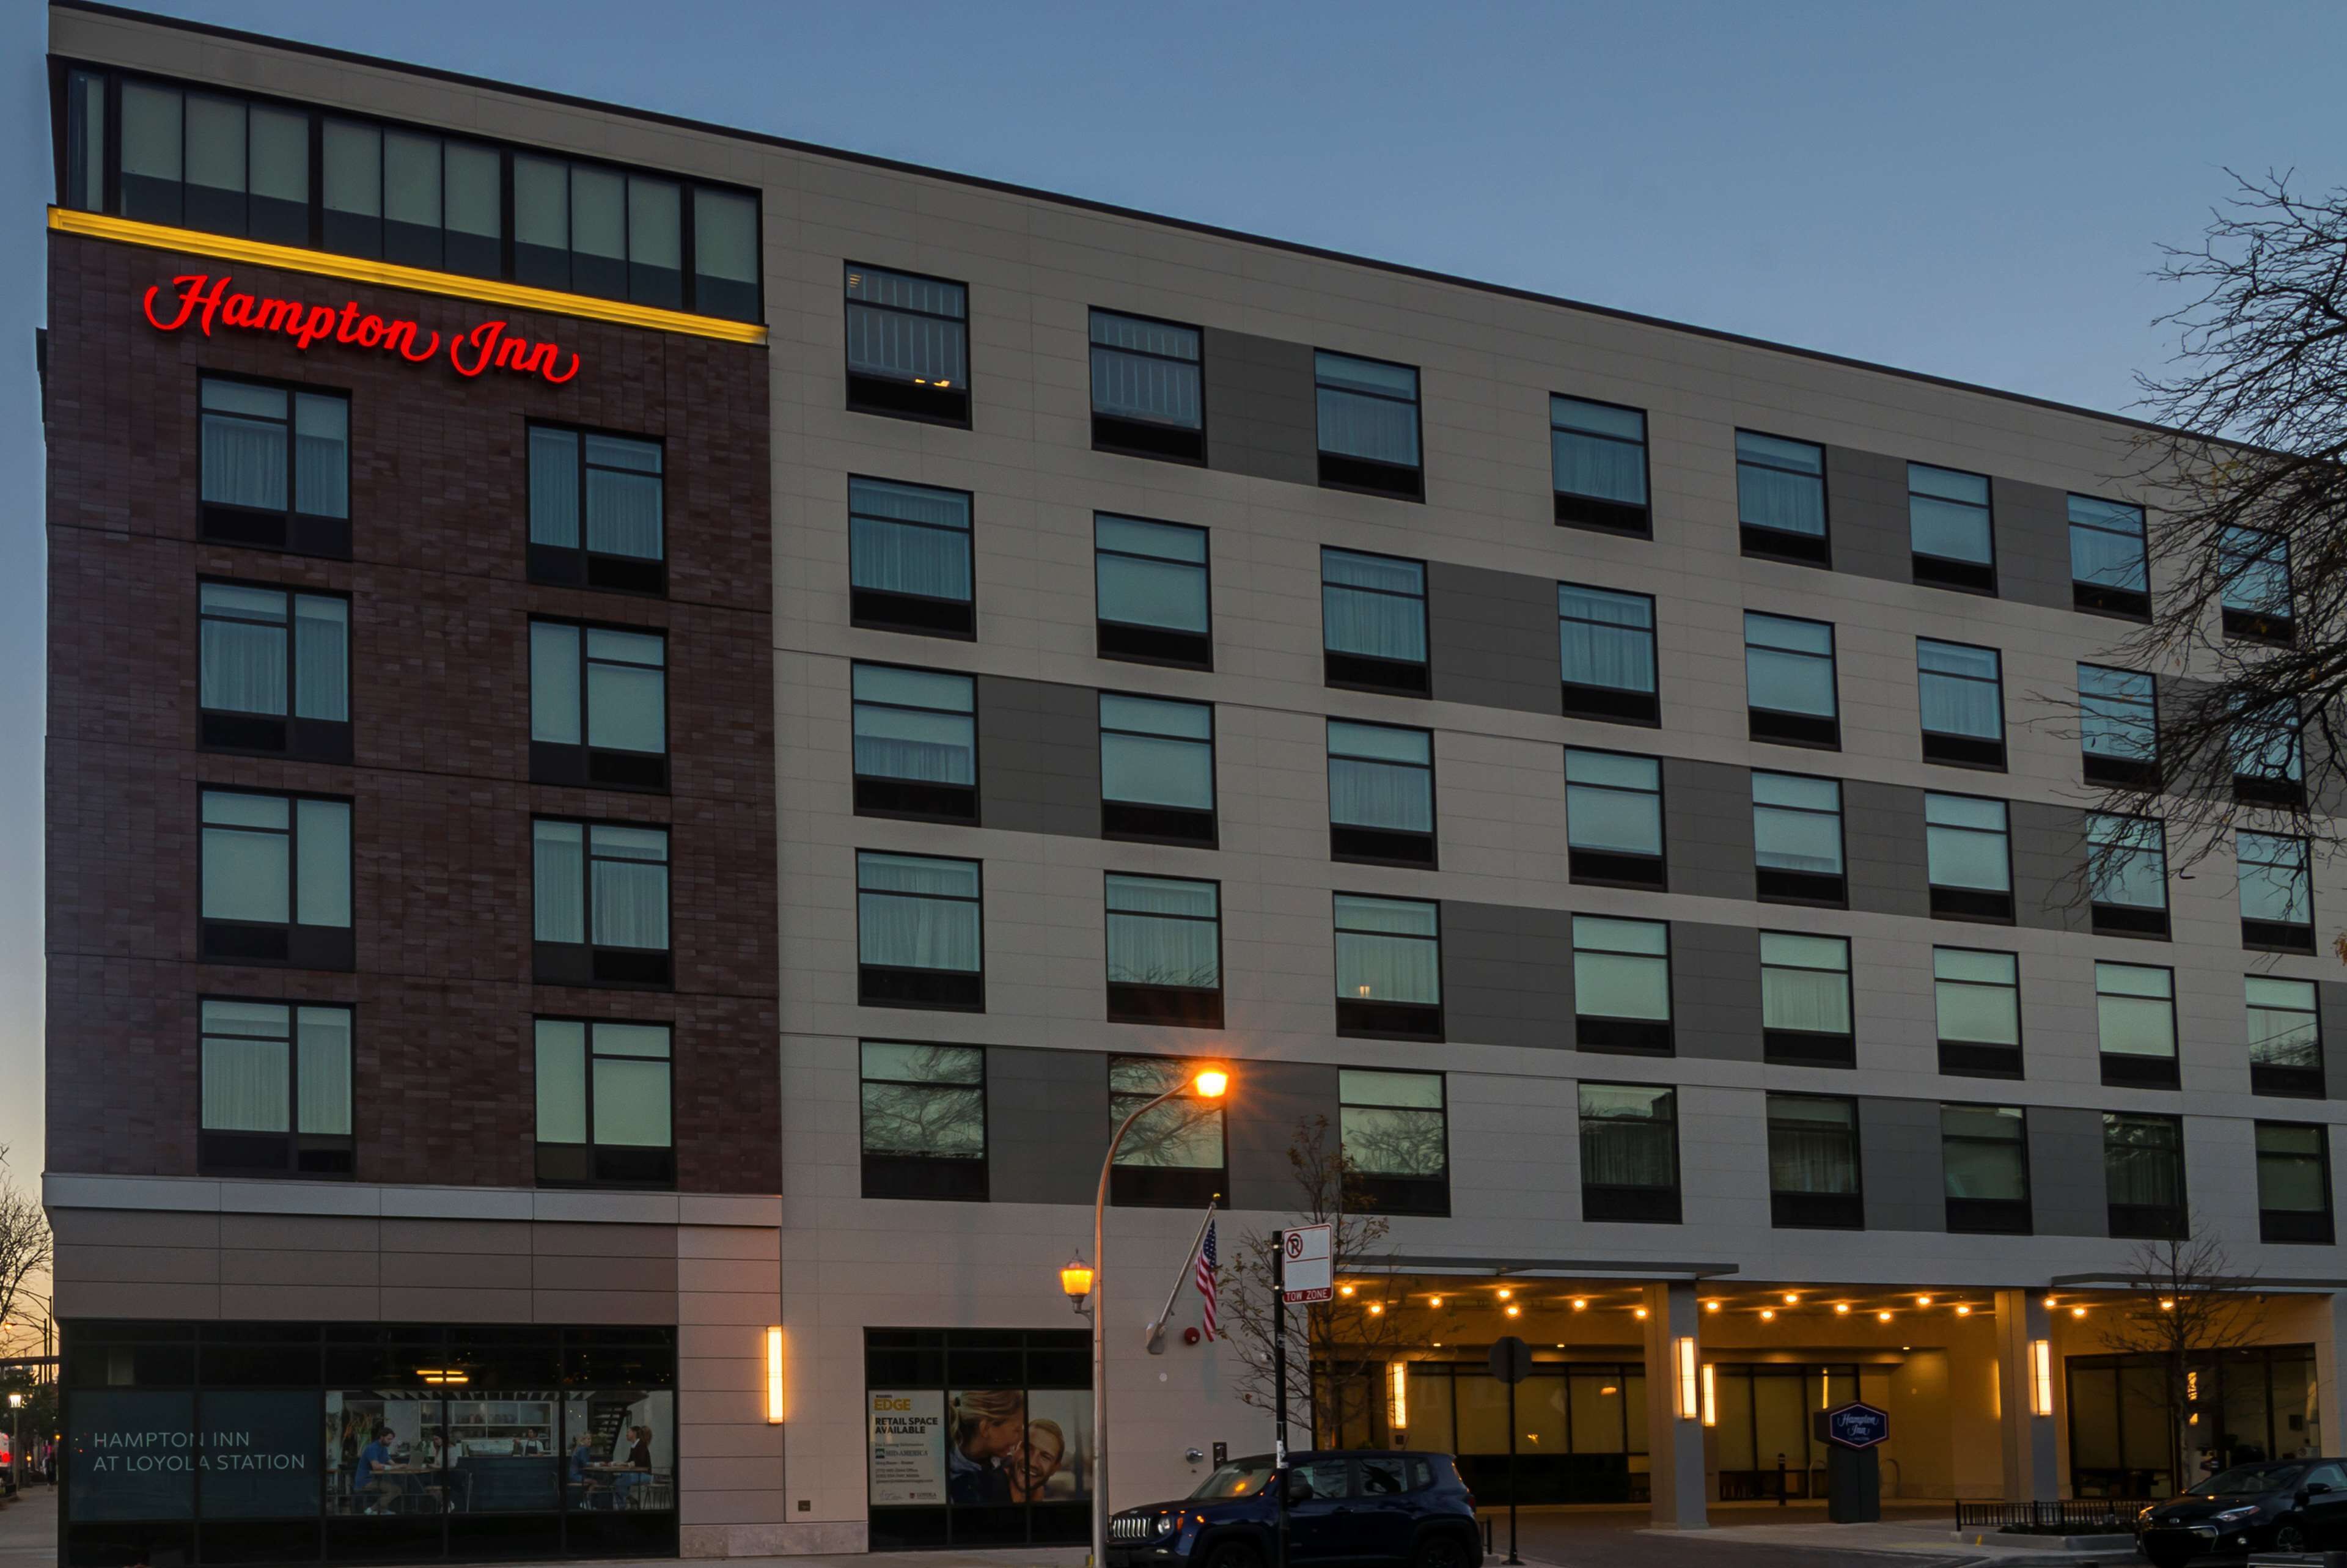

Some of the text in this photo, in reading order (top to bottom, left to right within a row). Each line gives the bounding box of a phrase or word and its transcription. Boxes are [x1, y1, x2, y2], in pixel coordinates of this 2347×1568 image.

[144, 274, 579, 384] Hampton Inn
[1286, 1289, 1328, 1302] TOW ZONE
[874, 1398, 911, 1411] EDGE
[875, 1417, 938, 1426] RETAIL SPACE
[1837, 1413, 1879, 1427] Hampton
[1846, 1424, 1870, 1437] Inn
[94, 1431, 249, 1448] HAMPTON INN
[93, 1454, 305, 1471] AT LOYOLA STATION
